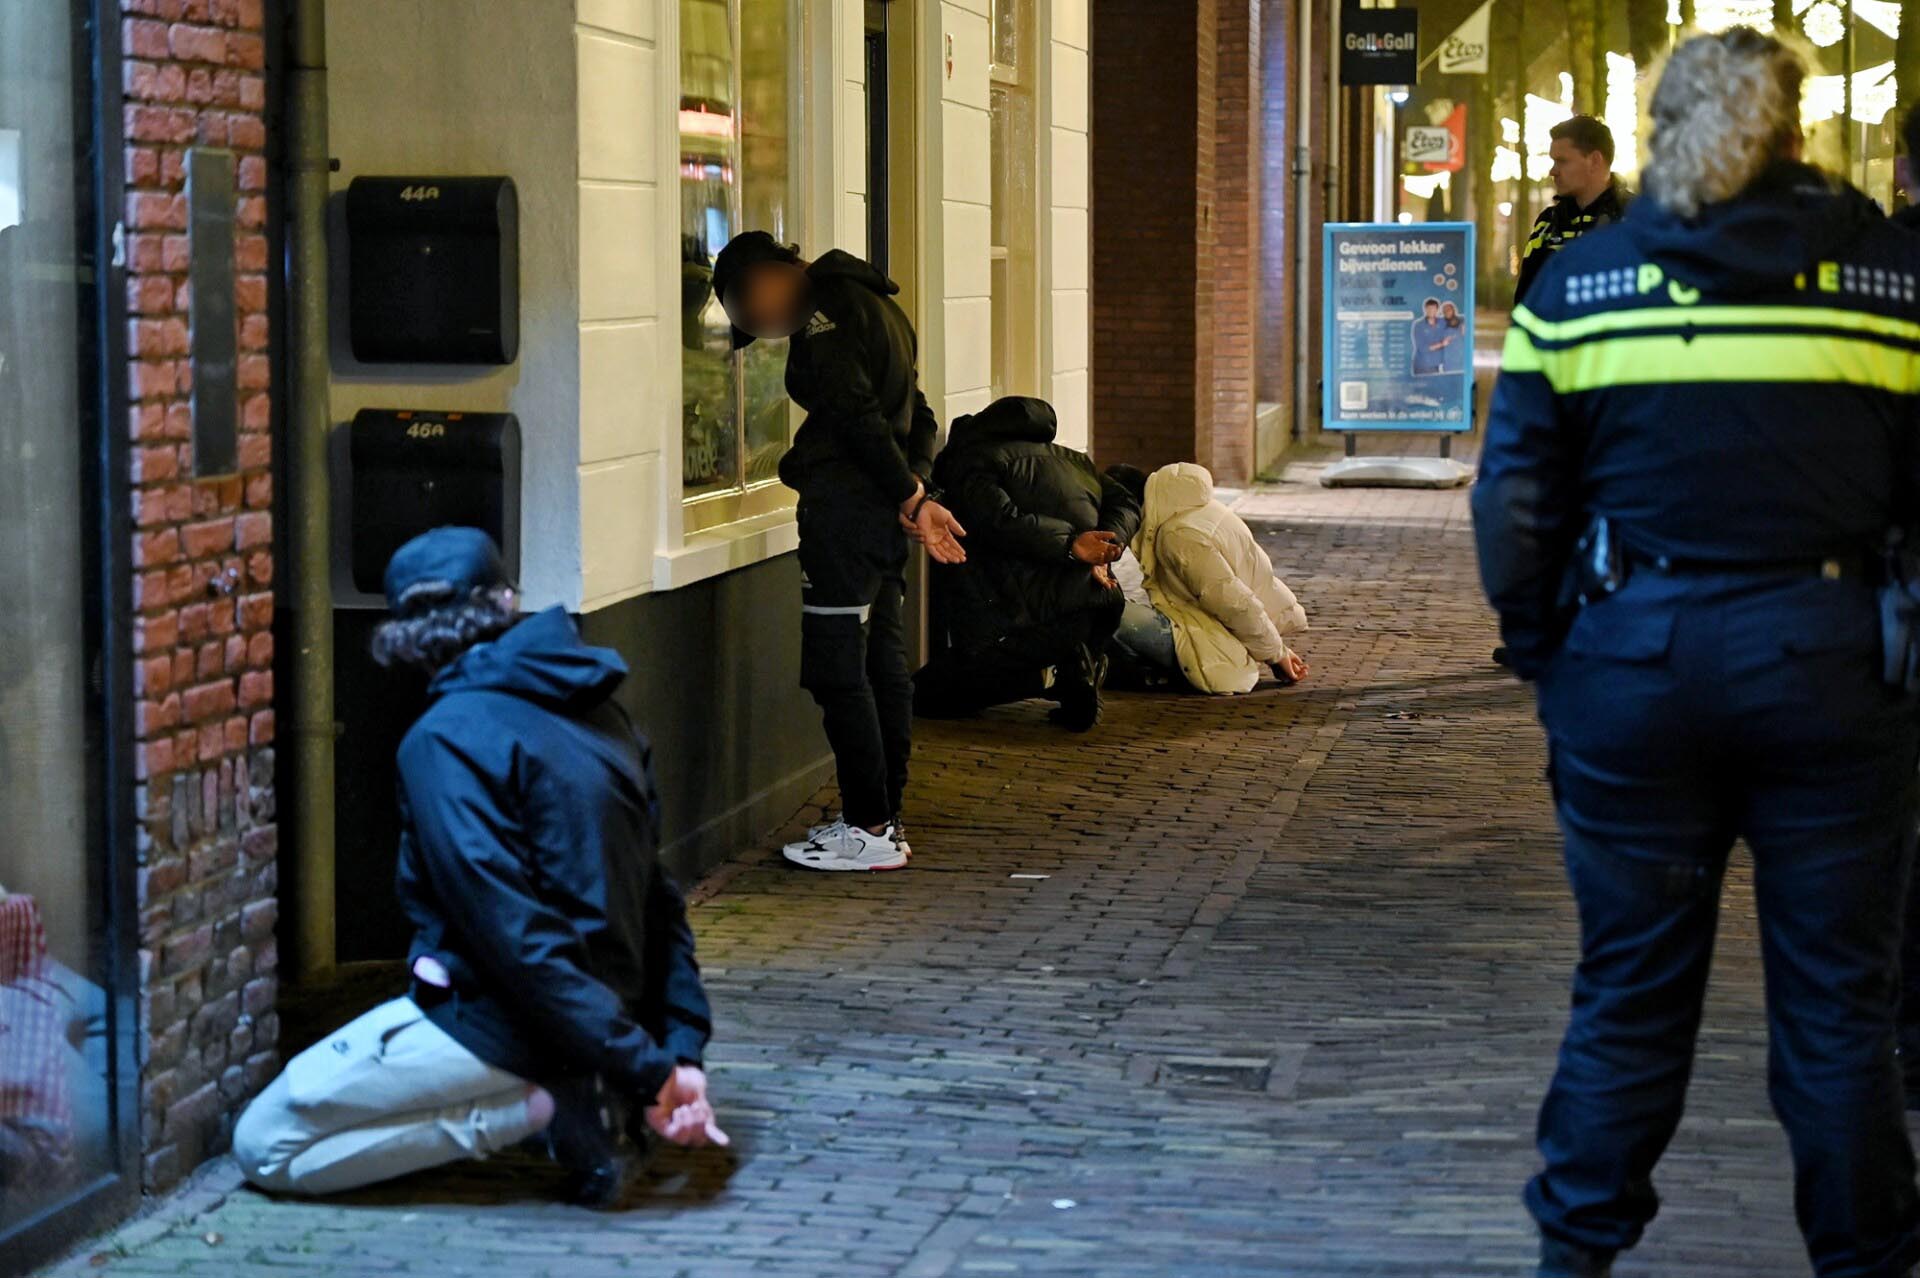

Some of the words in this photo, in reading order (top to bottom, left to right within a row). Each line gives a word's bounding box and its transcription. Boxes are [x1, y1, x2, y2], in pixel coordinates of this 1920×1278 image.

[1446, 37, 1484, 58] Etos
[1411, 130, 1444, 149] Etos
[400, 186, 440, 201] 44A
[1339, 240, 1397, 255] Gewoon
[1400, 240, 1445, 254] lekker
[1339, 258, 1427, 275] bijverdienen.
[406, 422, 445, 438] 46A
